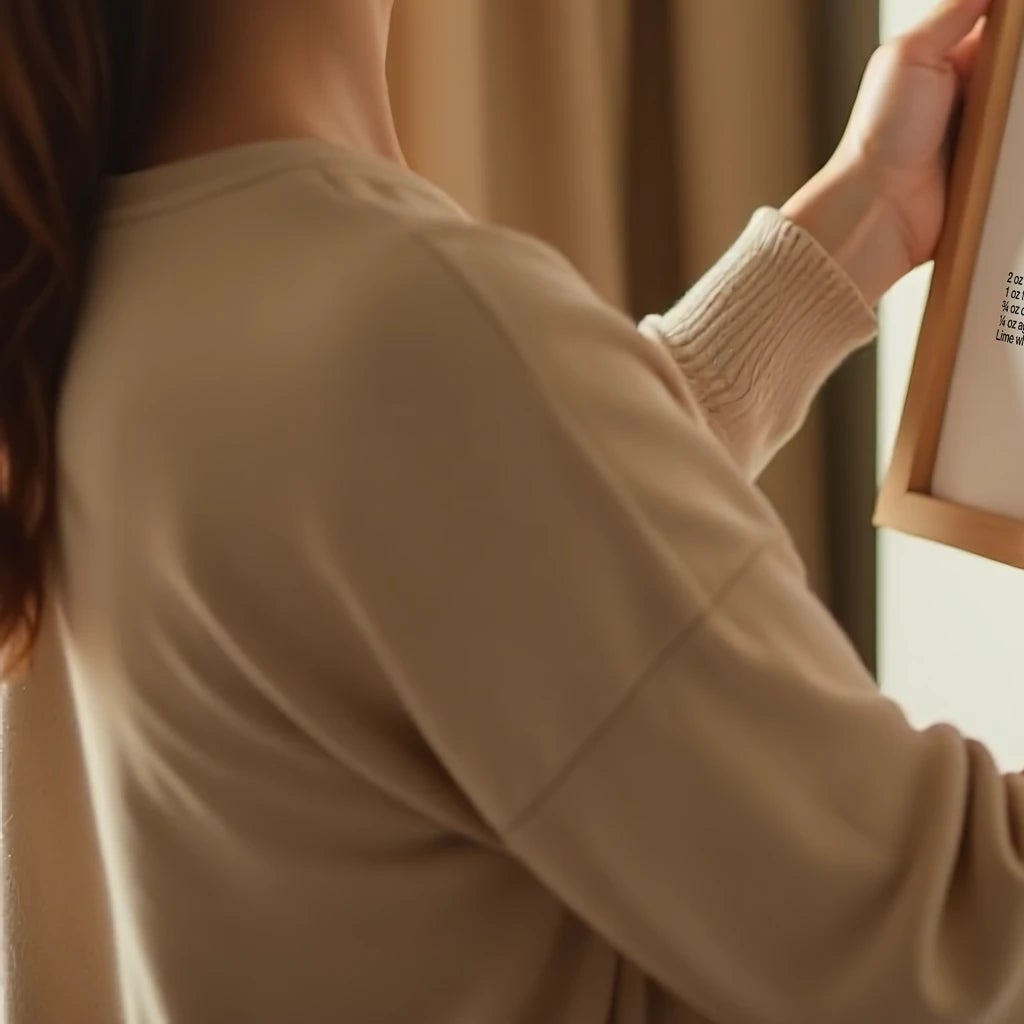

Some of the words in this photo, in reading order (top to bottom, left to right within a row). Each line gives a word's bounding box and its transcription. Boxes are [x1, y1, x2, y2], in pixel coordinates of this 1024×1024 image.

[1007, 272, 1014, 283] 2
[1014, 275, 1024, 286] oz
[1005, 286, 1009, 297] 1
[1010, 290, 1020, 300] oz
[1010, 305, 1020, 315] oz
[1008, 319, 1017, 330] oz
[996, 329, 1014, 344] Lime
